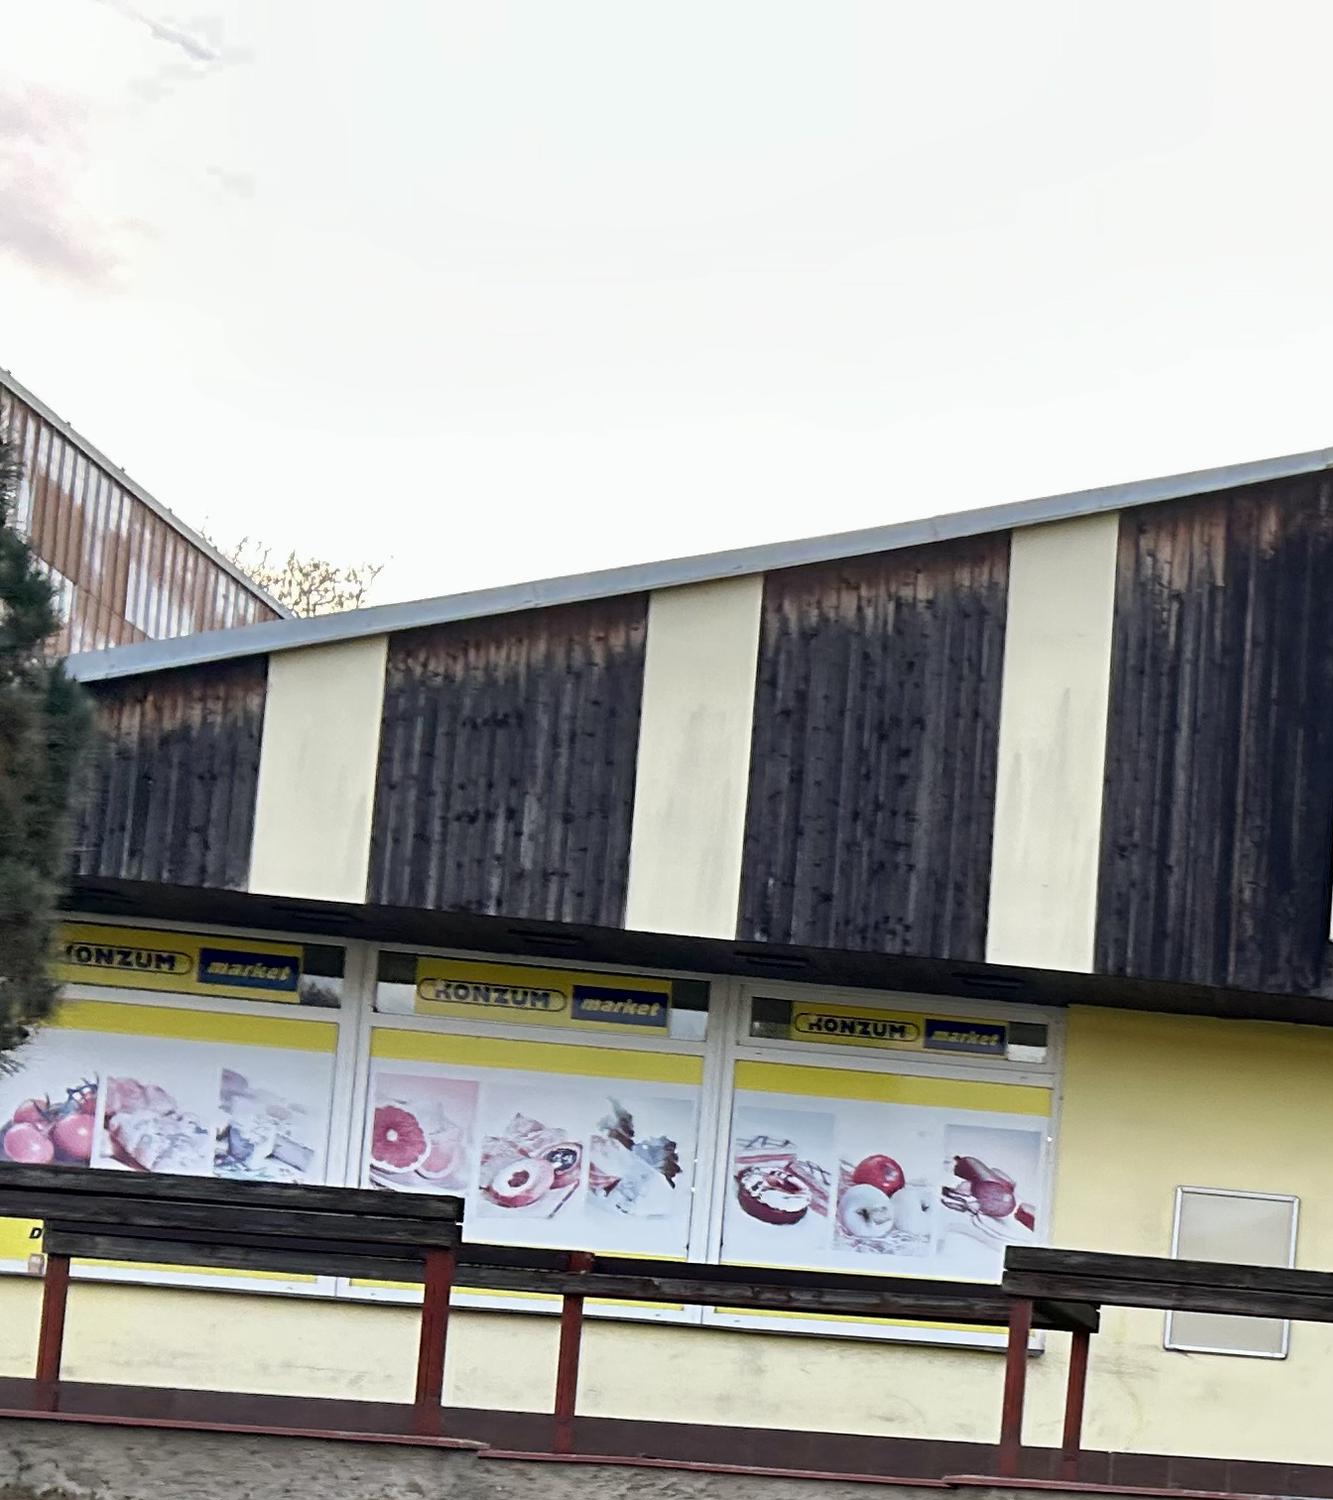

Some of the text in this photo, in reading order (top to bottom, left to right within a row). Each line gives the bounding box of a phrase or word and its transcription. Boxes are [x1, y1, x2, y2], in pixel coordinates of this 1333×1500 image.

[206, 961, 291, 981] market
[434, 980, 661, 1017] KONZUM market
[808, 1016, 999, 1046] KONZUM market
